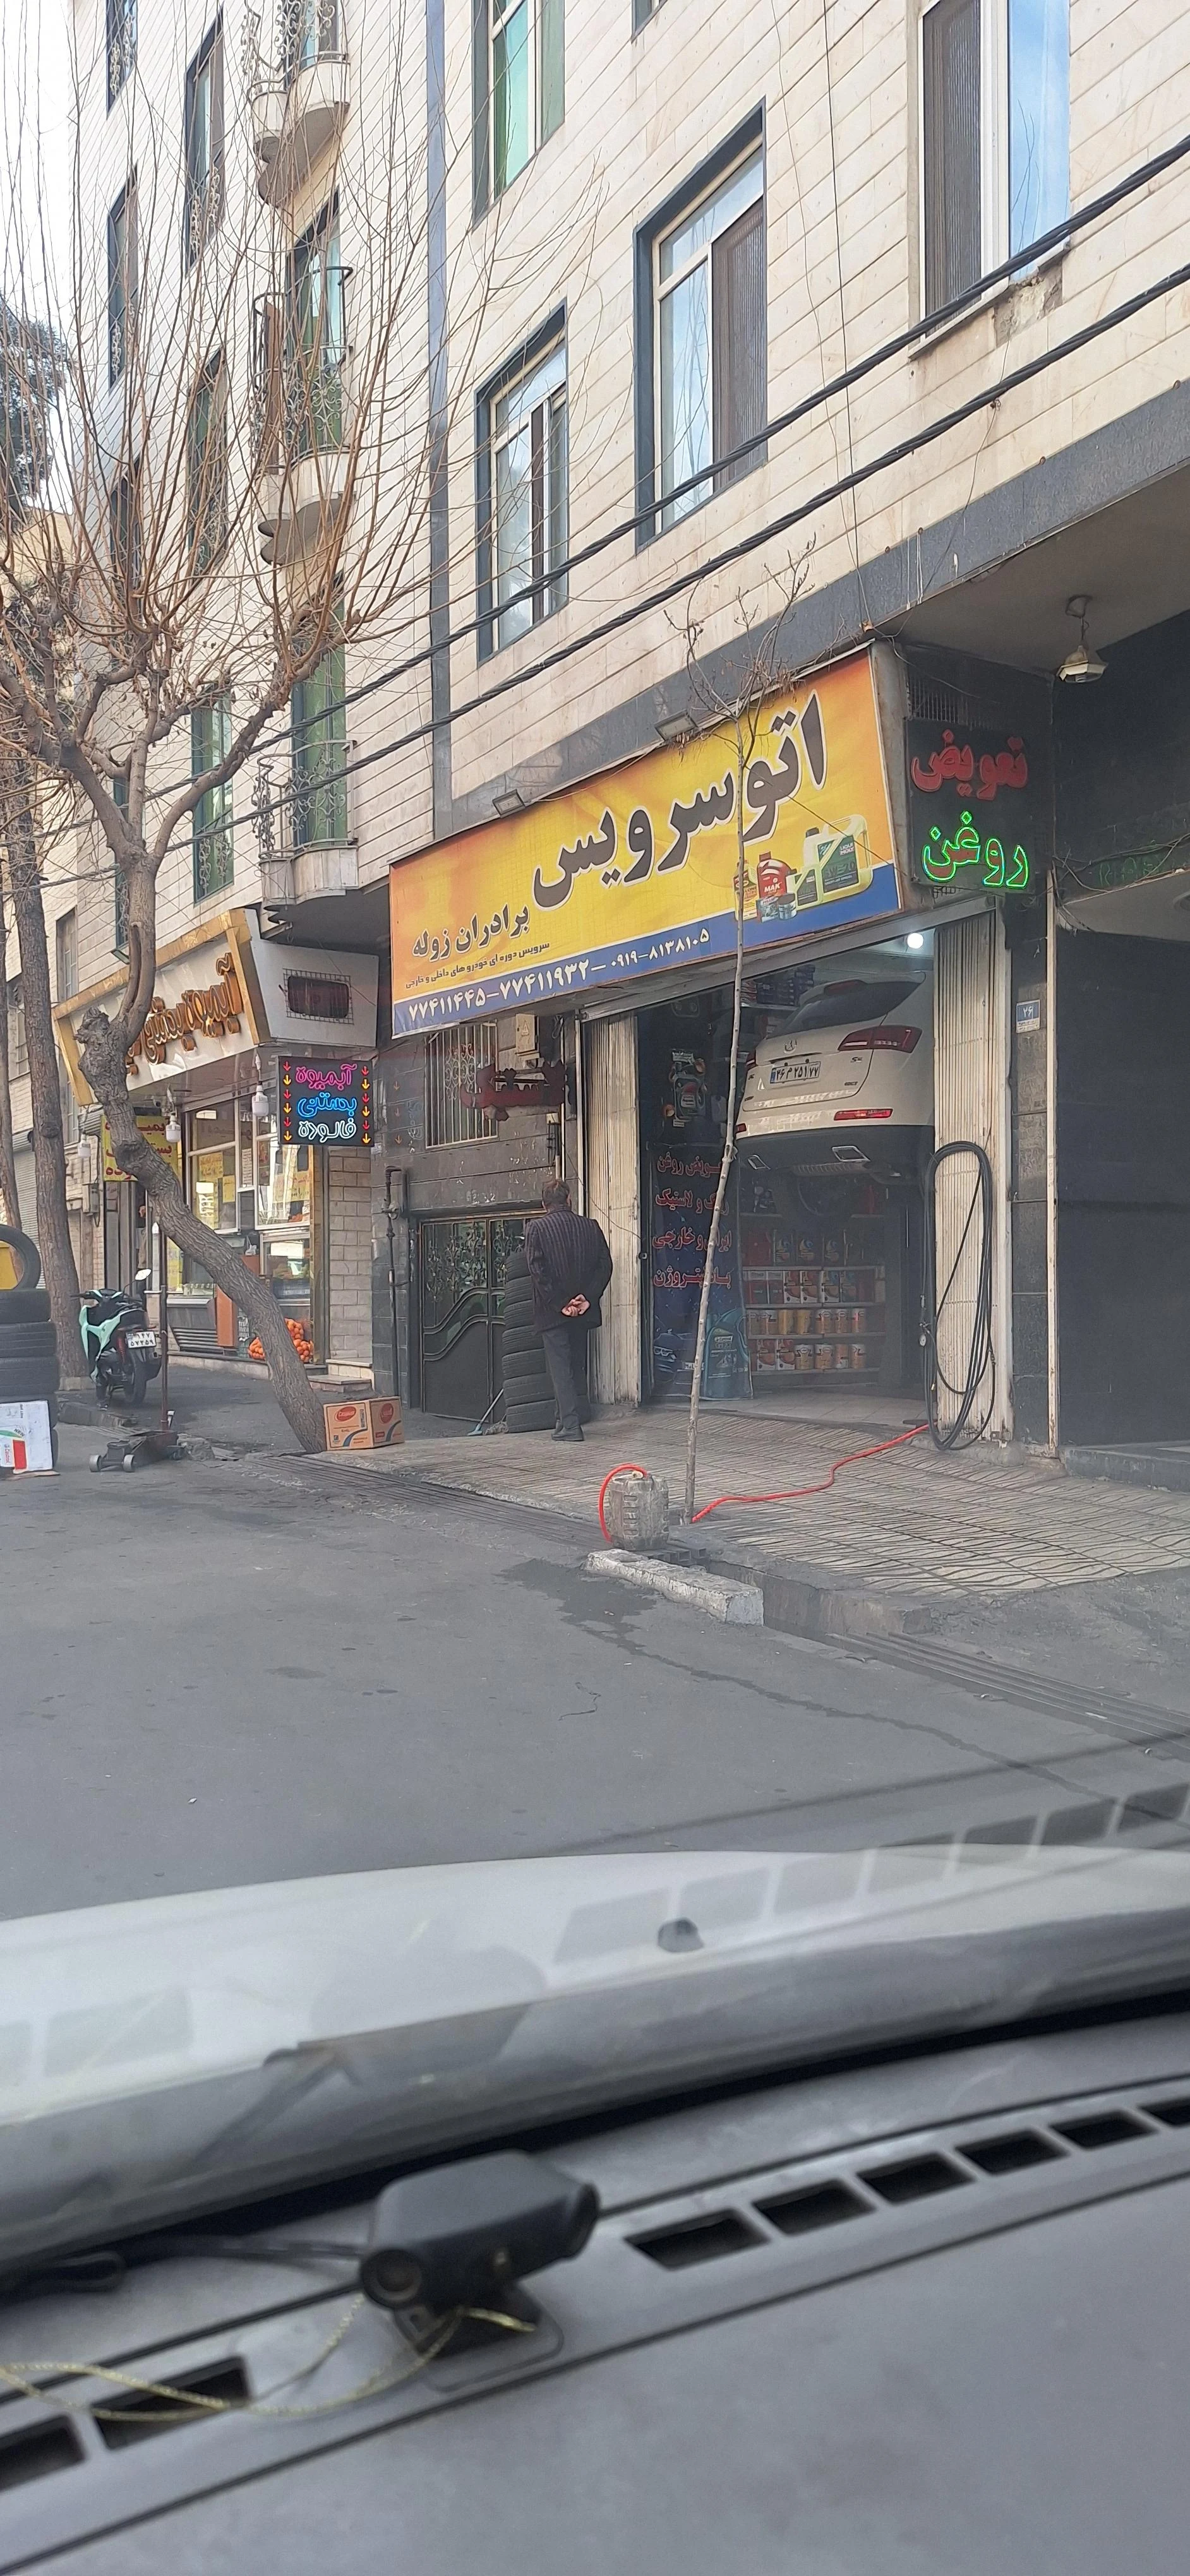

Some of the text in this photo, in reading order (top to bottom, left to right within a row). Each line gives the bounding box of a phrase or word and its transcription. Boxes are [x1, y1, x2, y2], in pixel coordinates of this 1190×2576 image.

[910, 728, 1029, 801] تعویض
[532, 768, 736, 910] سرویس
[922, 810, 1030, 889] روغن
[764, 881, 781, 893] MAK
[412, 903, 530, 962] برادران زوله
[500, 952, 517, 962] دوره
[519, 943, 550, 958] سرویس
[450, 963, 466, 977] های
[489, 954, 498, 967] ای
[406, 975, 424, 989] خارجی
[431, 968, 449, 982] داخلی
[296, 1063, 358, 1090] آبمیوه
[794, 1065, 807, 1078] ۲۵۱
[809, 1066, 819, 1077] ۷۷
[297, 1092, 358, 1118] بستنی
[298, 1117, 357, 1143] فالوده
[657, 1151, 684, 1176] روغن
[656, 1188, 694, 1211] لاستیک
[695, 1198, 703, 1214] و
[652, 1226, 696, 1250] خارجی
[695, 1235, 704, 1251] و
